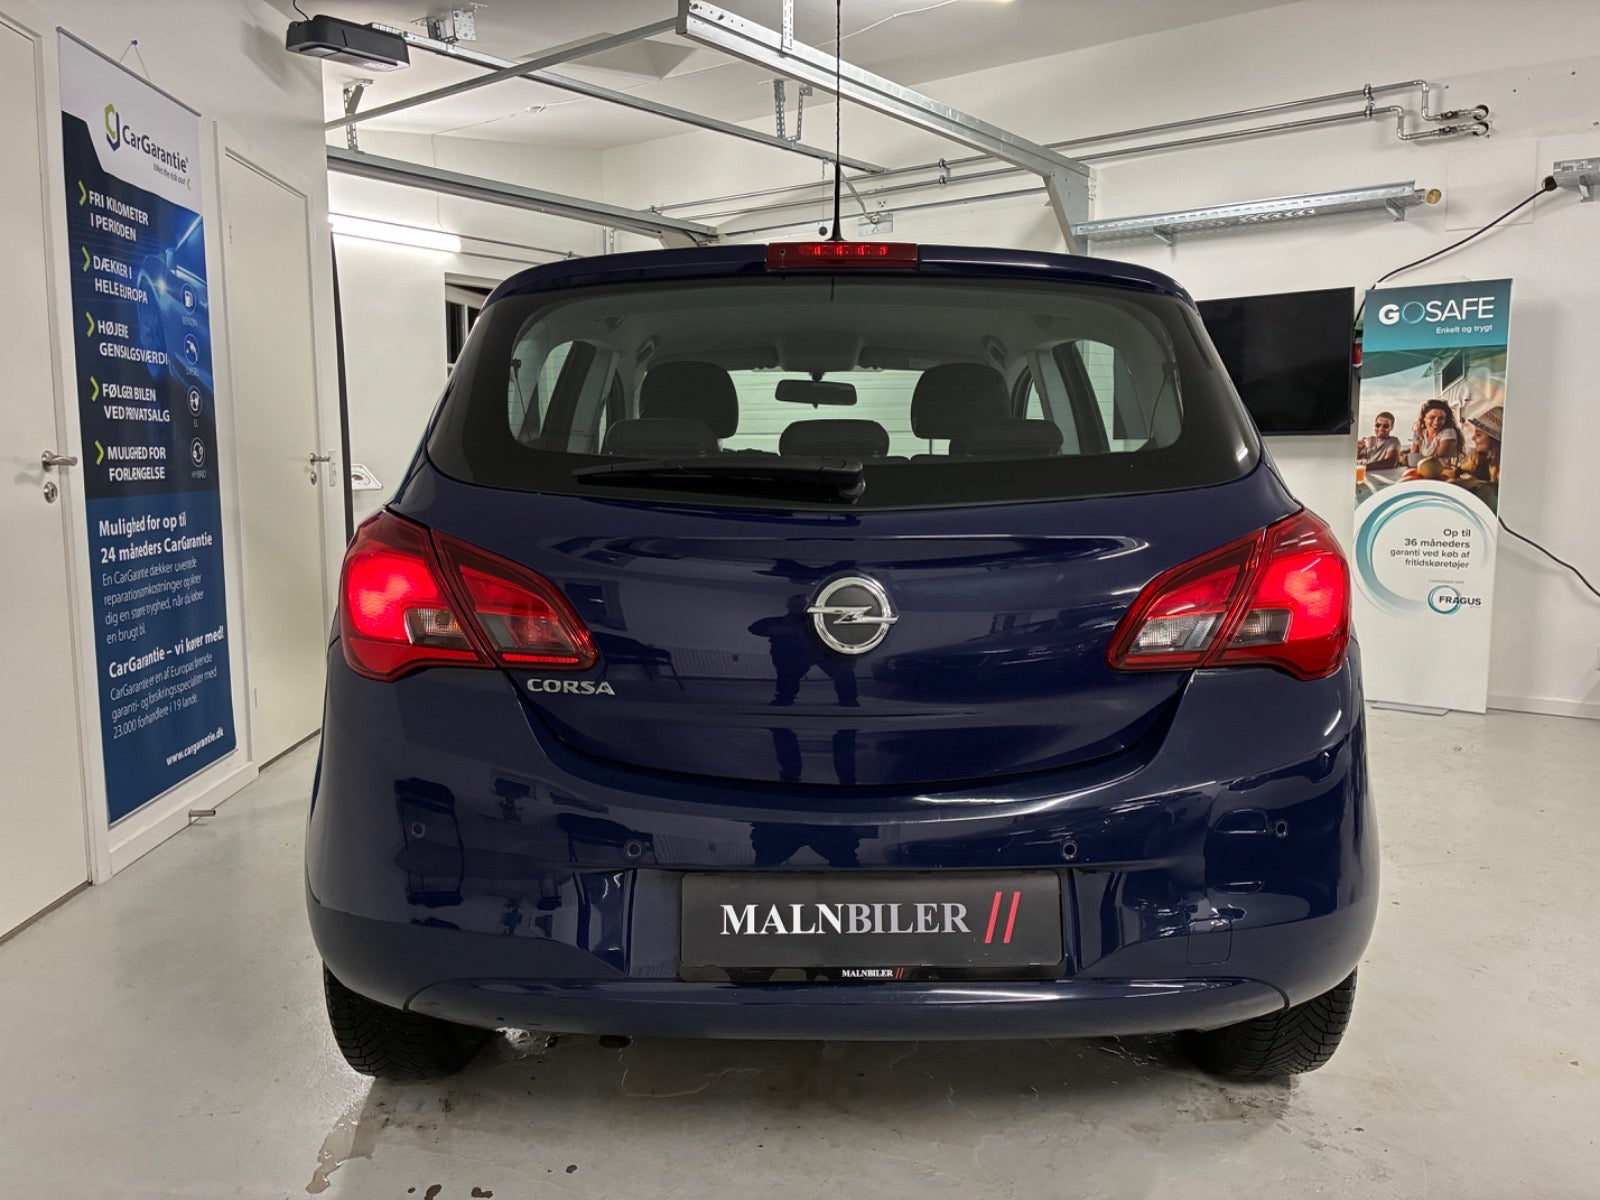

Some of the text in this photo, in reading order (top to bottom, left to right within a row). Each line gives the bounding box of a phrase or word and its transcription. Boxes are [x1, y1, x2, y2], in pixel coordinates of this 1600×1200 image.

[122, 125, 187, 173] CarGarantie
[89, 190, 149, 226] FRI KILOMETER
[90, 213, 137, 242] I PERIODEN
[93, 255, 128, 278] DÆKKER
[94, 278, 149, 304] HELE EUROPA
[97, 320, 129, 339] HØJERE
[1436, 324, 1493, 335] Enkelt og trygt
[99, 342, 168, 365] GENSALGSVÆRDI
[102, 383, 157, 402] FØLGER BILEN
[104, 405, 170, 422] VED PRIVATSALG
[107, 446, 167, 461] MULIGHED FOR
[109, 466, 166, 482] FORLÆNGELSE
[99, 511, 187, 538] Mulighed for op til
[1443, 528, 1471, 539] Op til
[101, 531, 213, 564] 24 måneders CarGarantie
[1404, 538, 1471, 549] 36 måneders
[1390, 548, 1470, 559] garanti ved køb af
[1405, 558, 1469, 570] fritidskøretøjer
[102, 572, 113, 587] En
[1439, 595, 1482, 606] FRAGUS
[105, 611, 118, 627] dig
[119, 610, 130, 622] en
[106, 632, 117, 645] en
[118, 626, 139, 643] brugt
[109, 646, 165, 679] CarGarantie
[174, 639, 185, 656] vi
[185, 637, 203, 652] kører
[204, 625, 225, 645] med!
[527, 678, 616, 696] CORSA
[113, 718, 138, 740] 23.000
[173, 698, 182, 711] 19
[166, 726, 224, 766] www.cargarantie.dk
[720, 903, 972, 935] MALNBILER
[841, 968, 894, 978] MALNBILER
